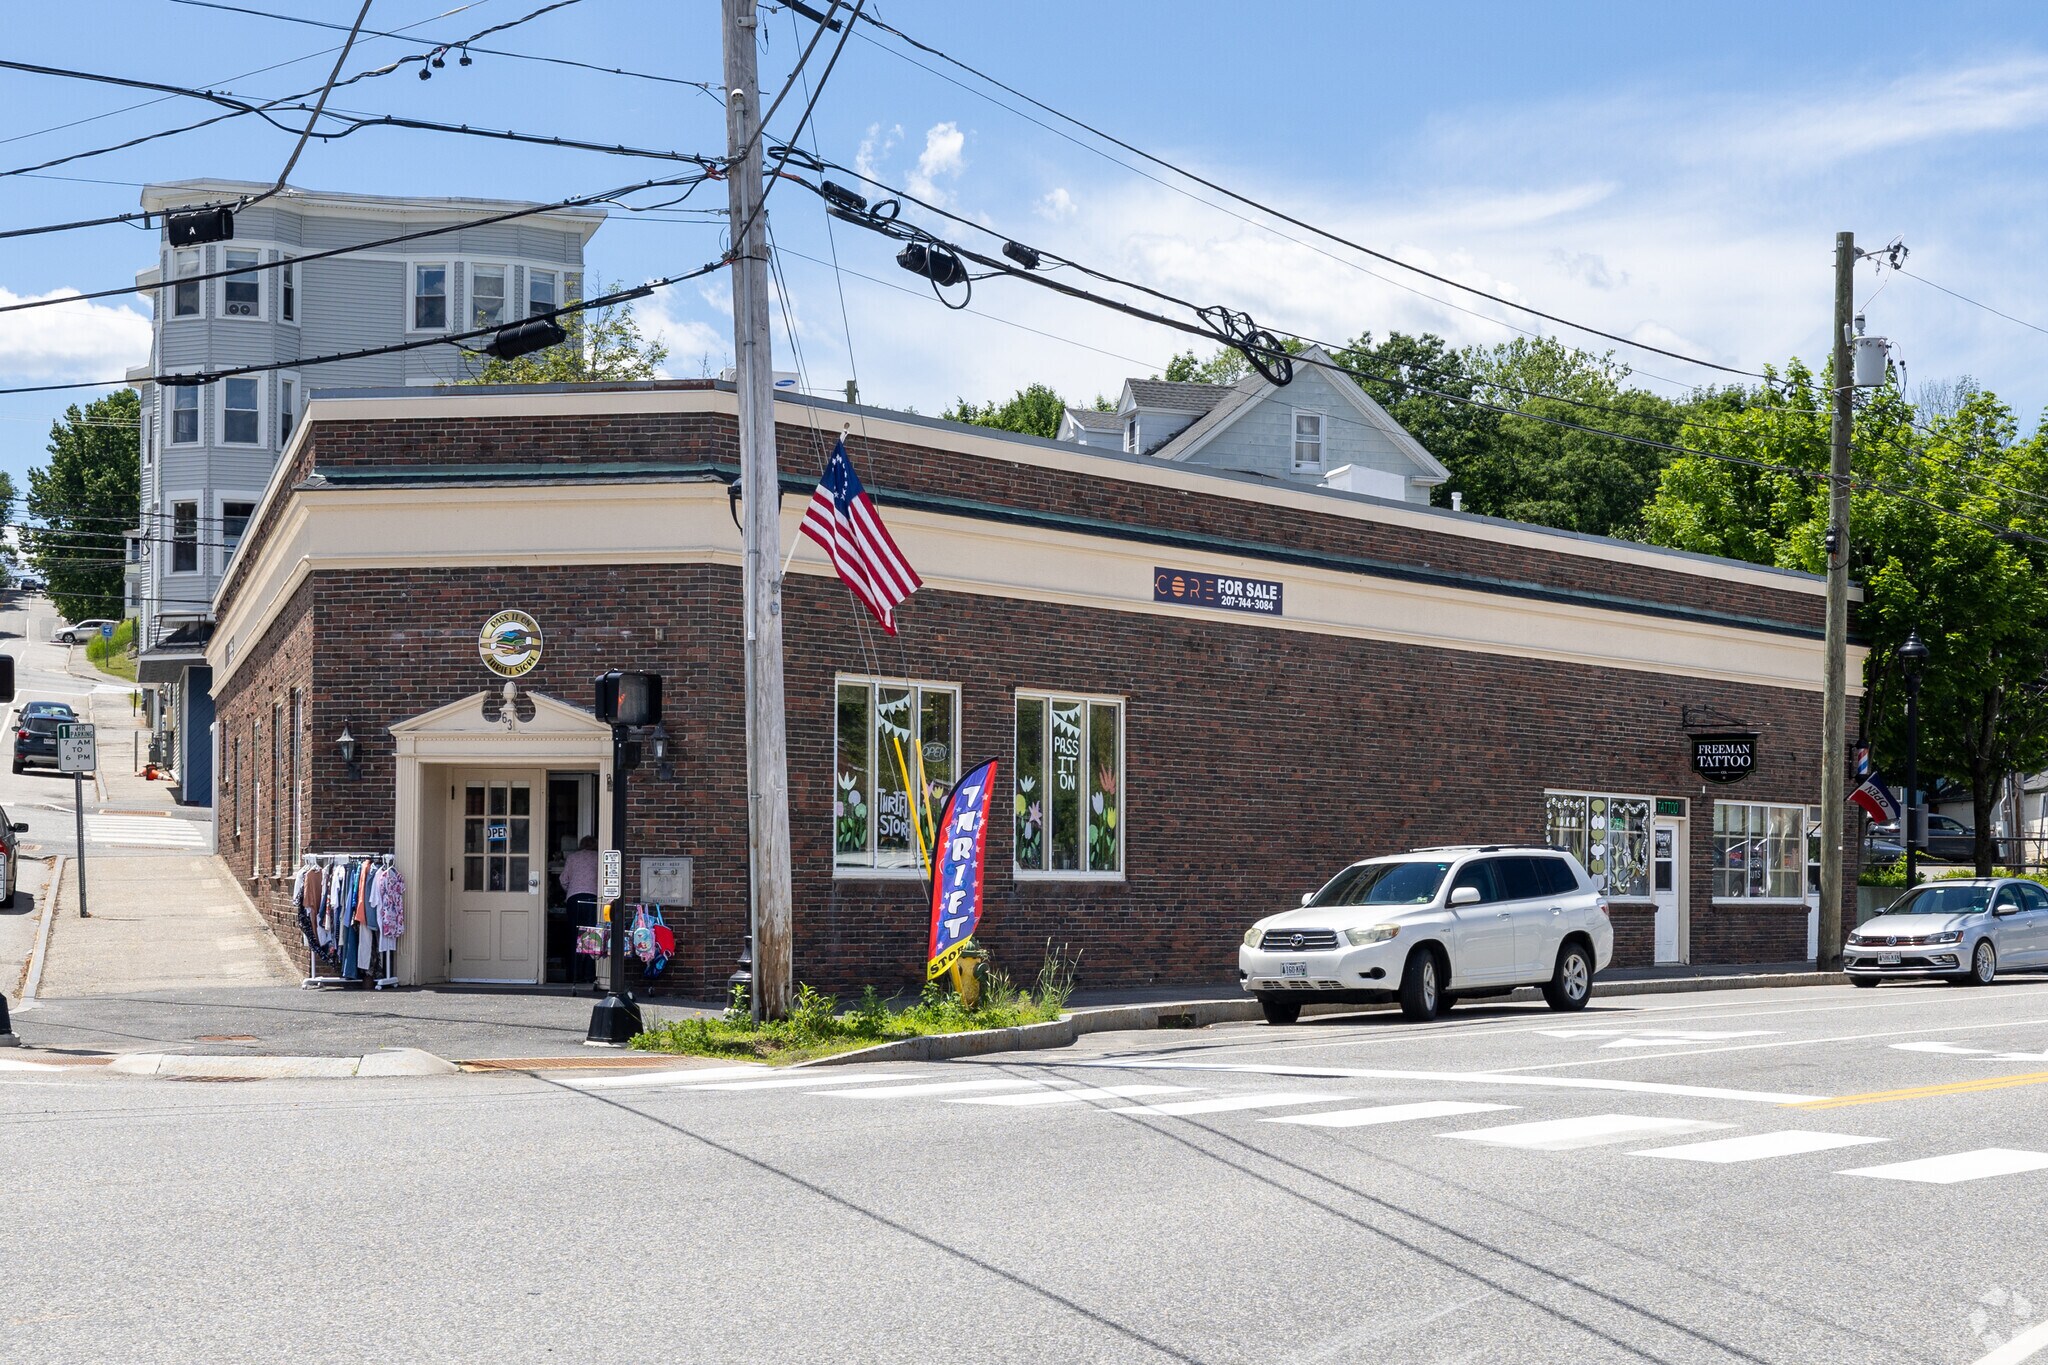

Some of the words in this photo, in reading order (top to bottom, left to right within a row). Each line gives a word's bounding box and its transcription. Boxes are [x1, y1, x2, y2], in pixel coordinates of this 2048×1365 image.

[1217, 579, 1243, 596] FOR
[1246, 583, 1278, 600] SALE
[1221, 595, 1273, 611] 207-744-3084
[490, 613, 509, 628] PASS
[520, 617, 532, 627] ON
[487, 656, 512, 675] THRIFT
[515, 656, 536, 673] STORE
[62, 726, 67, 738] 1
[922, 746, 947, 758] OPEN
[1054, 736, 1079, 756] PASS
[1698, 743, 1750, 754] FREEMAN
[1057, 756, 1077, 774] IT
[1696, 755, 1751, 767] TATTOO
[1060, 773, 1076, 790] ON
[878, 787, 908, 819] THRIFT
[1865, 785, 1889, 808] OPEN
[1657, 801, 1679, 814] TATTOO
[880, 814, 910, 841] STORE
[944, 785, 981, 939] THRIFT
